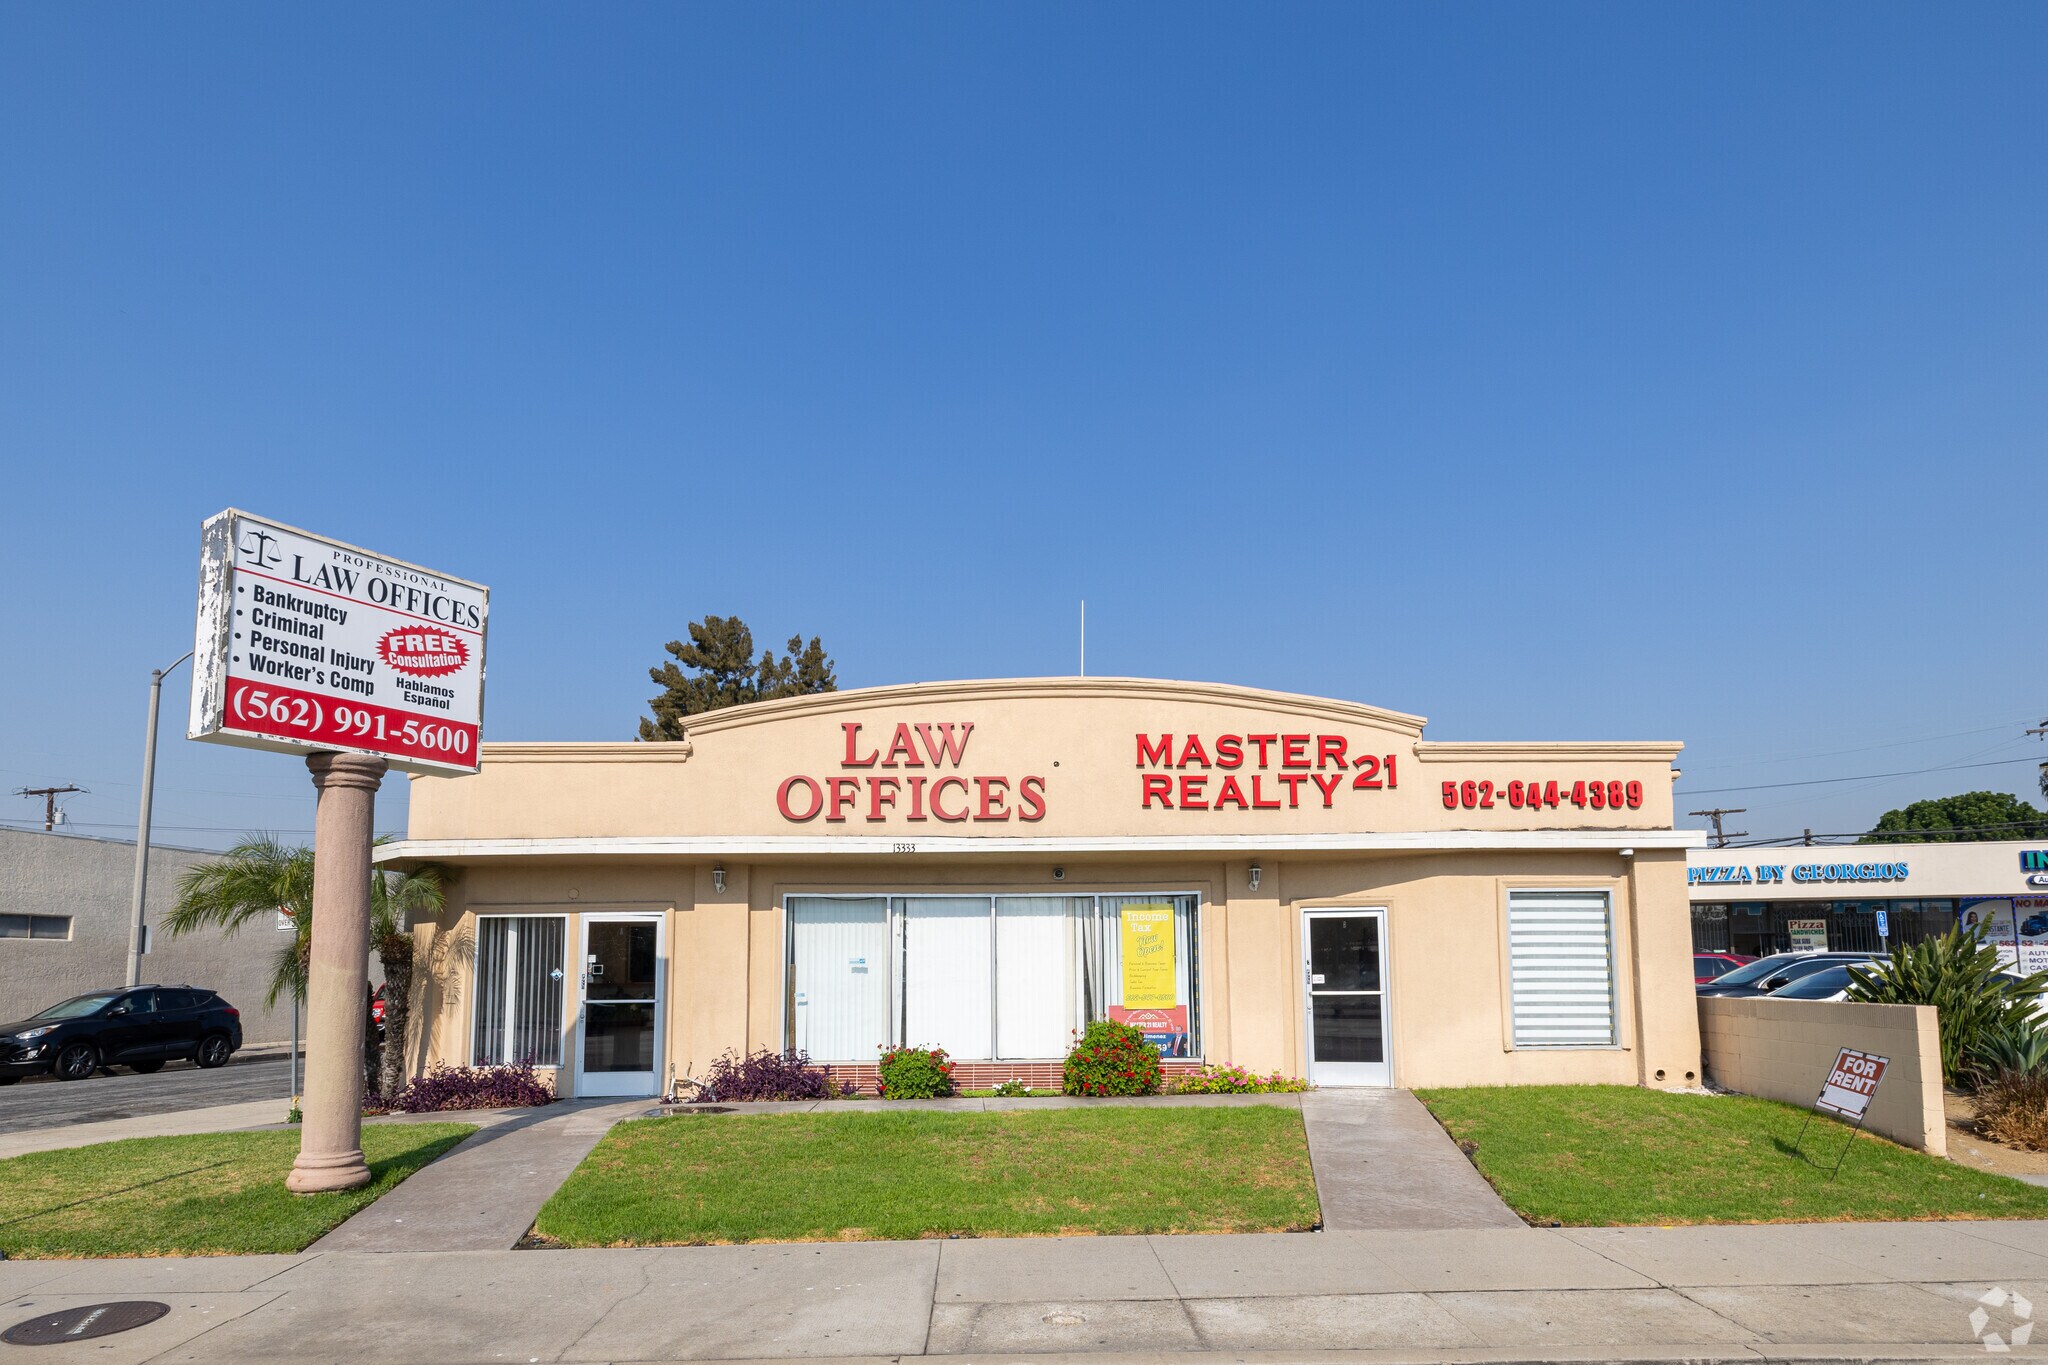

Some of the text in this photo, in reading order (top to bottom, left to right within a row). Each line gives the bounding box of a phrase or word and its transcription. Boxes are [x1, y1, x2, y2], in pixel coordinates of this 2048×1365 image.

[333, 551, 448, 592] PROFESSIONAL
[253, 584, 347, 625] Bankruptcy
[293, 554, 480, 629] LAW OFFICES
[252, 607, 324, 640] Criminal
[250, 631, 375, 675] Personal Injury
[388, 634, 458, 653] FREE
[249, 653, 375, 697] Worker's Comp
[388, 652, 462, 668] Consultation
[396, 677, 455, 699] Hablamos
[403, 691, 450, 710] Español
[233, 685, 469, 754] (562) 991-5600
[840, 722, 975, 767] LAW
[1135, 733, 1349, 769] MASTER
[1352, 754, 1398, 789] 21
[776, 775, 1046, 822] OFFICES
[1141, 774, 1343, 809] REALTY
[1442, 780, 1643, 810] 562-644-4389
[893, 843, 916, 854] 13333
[1687, 862, 1909, 882] PIZZA BY GEORGIOS
[1127, 912, 1169, 921] Income
[2015, 900, 2032, 909] NO
[1131, 923, 1151, 932] Tax
[1789, 921, 1825, 929] Pizza
[1831, 1070, 1876, 1094] RENT
[1843, 1057, 1877, 1077] FOR
